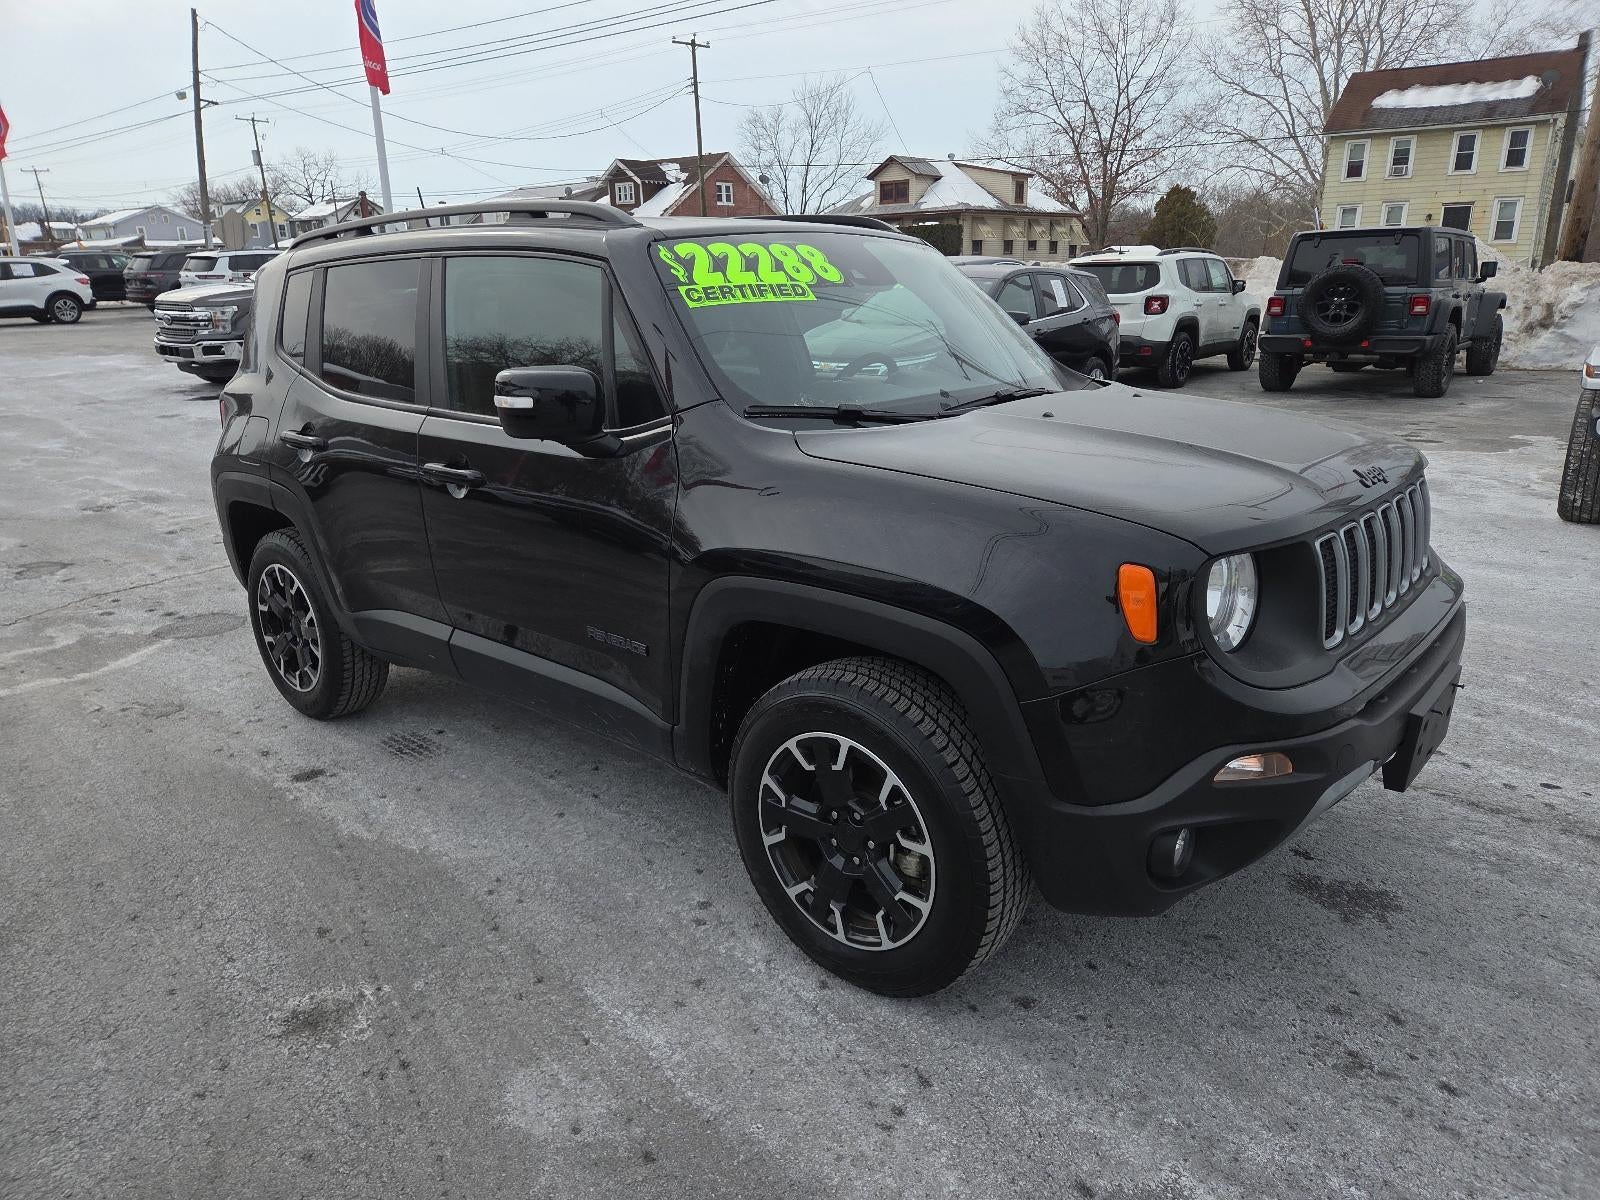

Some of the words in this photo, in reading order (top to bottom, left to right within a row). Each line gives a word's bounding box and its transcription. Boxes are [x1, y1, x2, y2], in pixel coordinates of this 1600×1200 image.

[658, 242, 844, 285] $22288
[685, 283, 808, 303] CERTIFIED
[1352, 465, 1389, 488] Jeep
